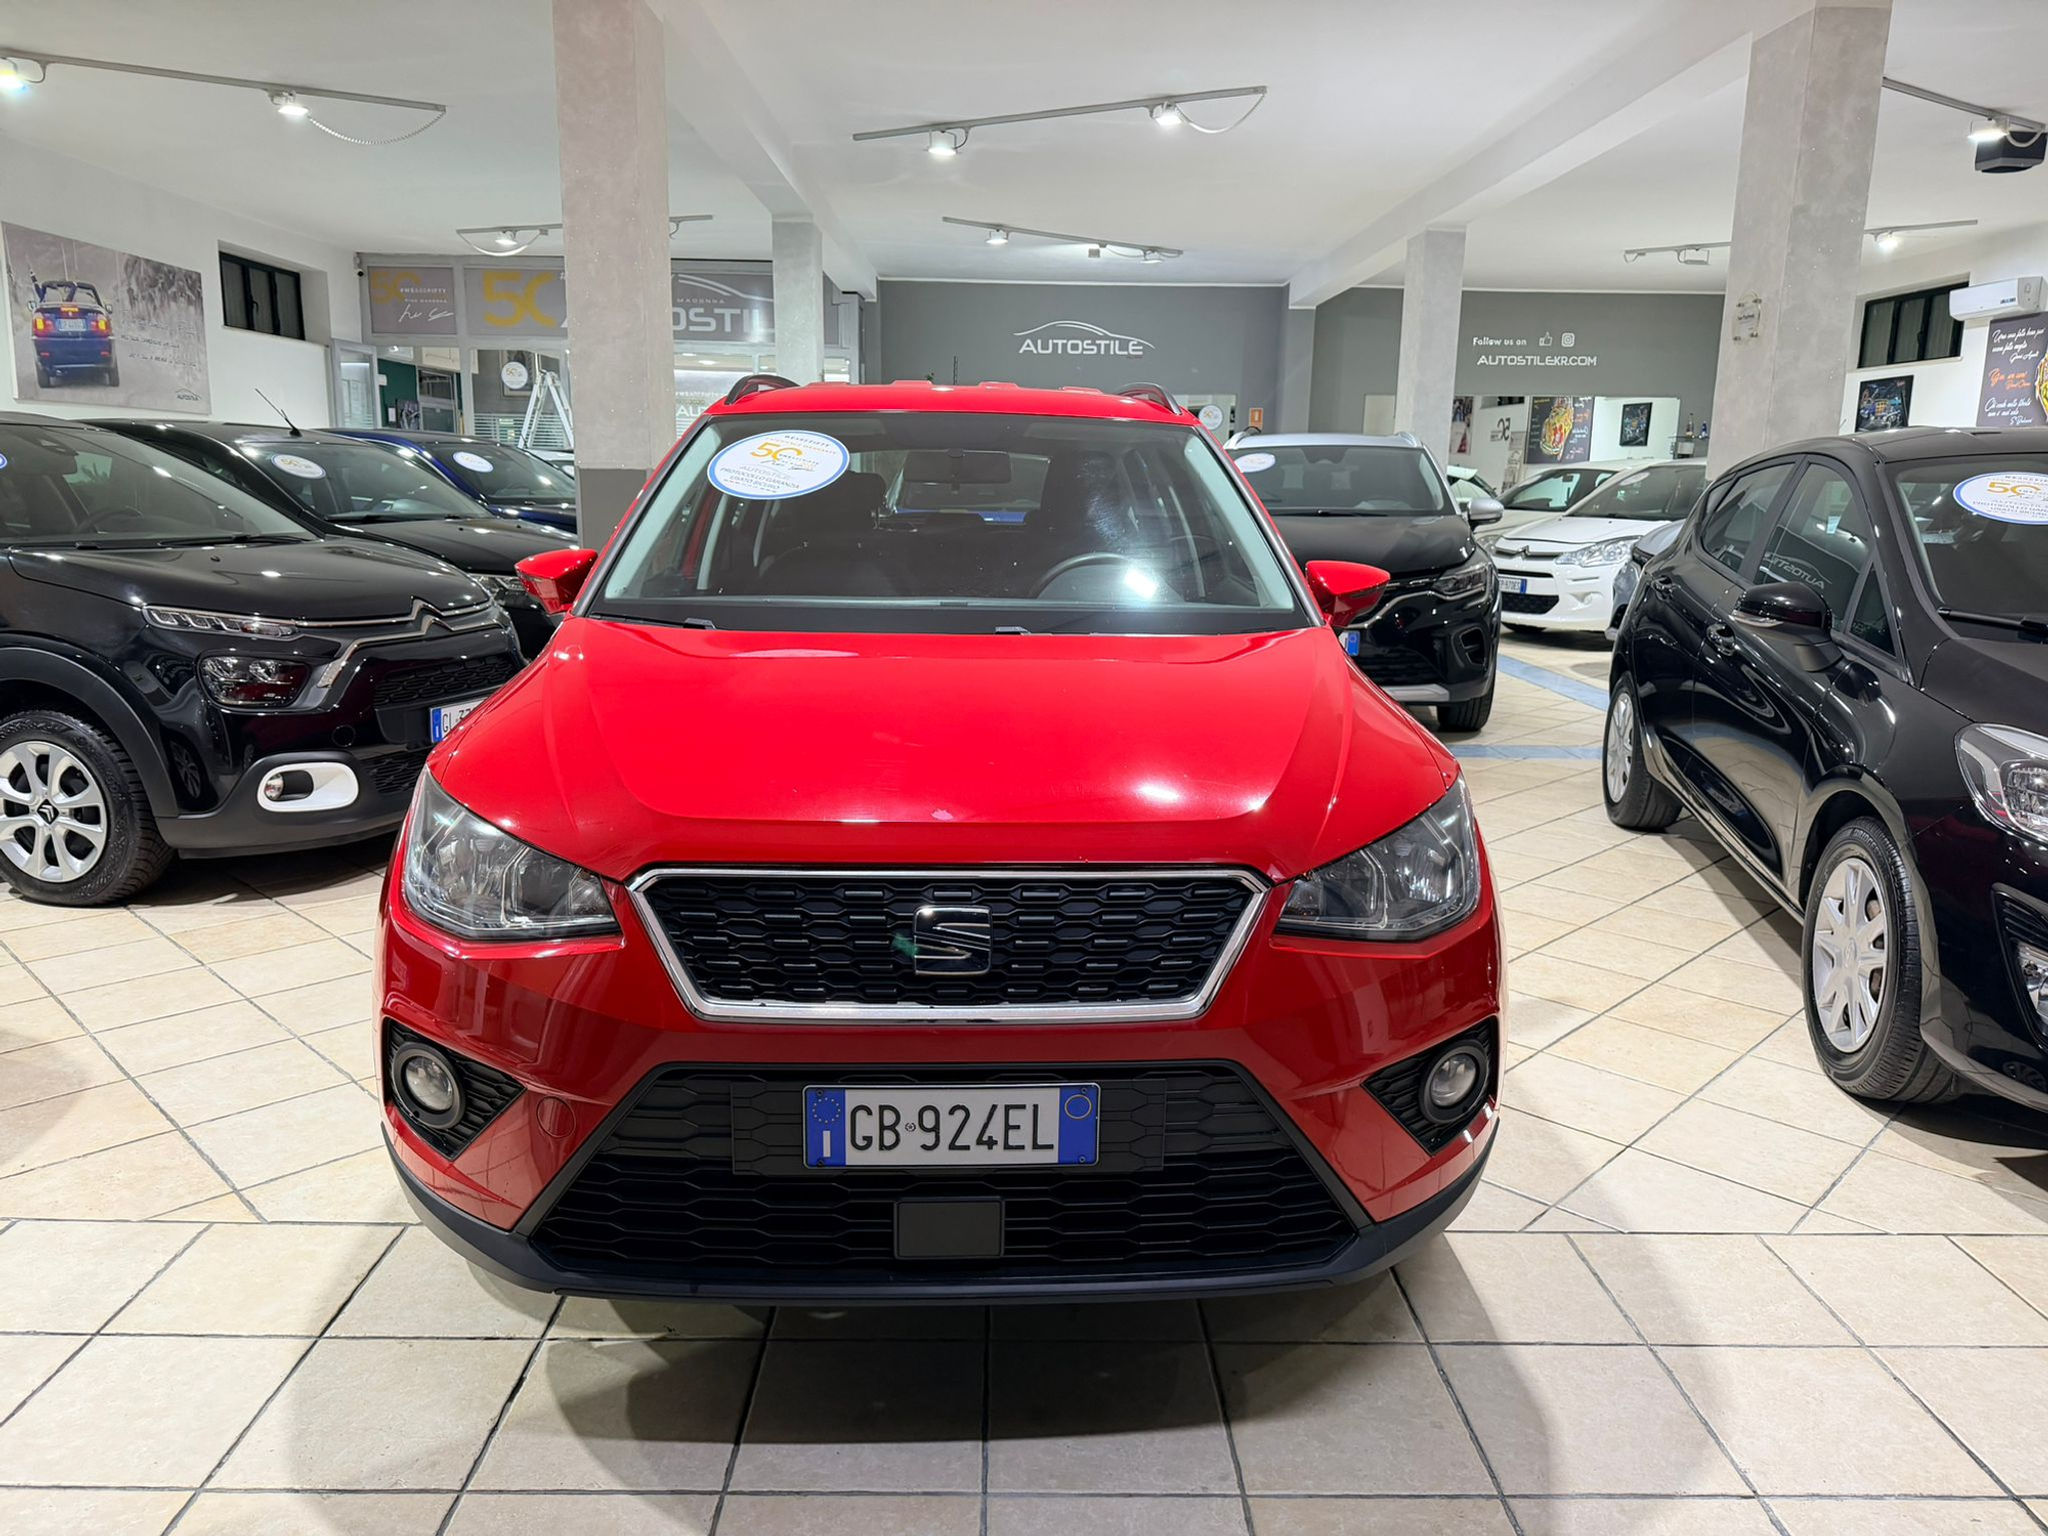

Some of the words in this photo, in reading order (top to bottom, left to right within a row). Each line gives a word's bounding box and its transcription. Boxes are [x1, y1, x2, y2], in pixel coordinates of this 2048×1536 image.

[1018, 338, 1143, 355] AUTOSTILE
[1473, 336, 1501, 346] Follow
[1504, 338, 1514, 346] us
[1516, 338, 1527, 346] on
[1477, 355, 1598, 366] AUTOSTILEKR.COM
